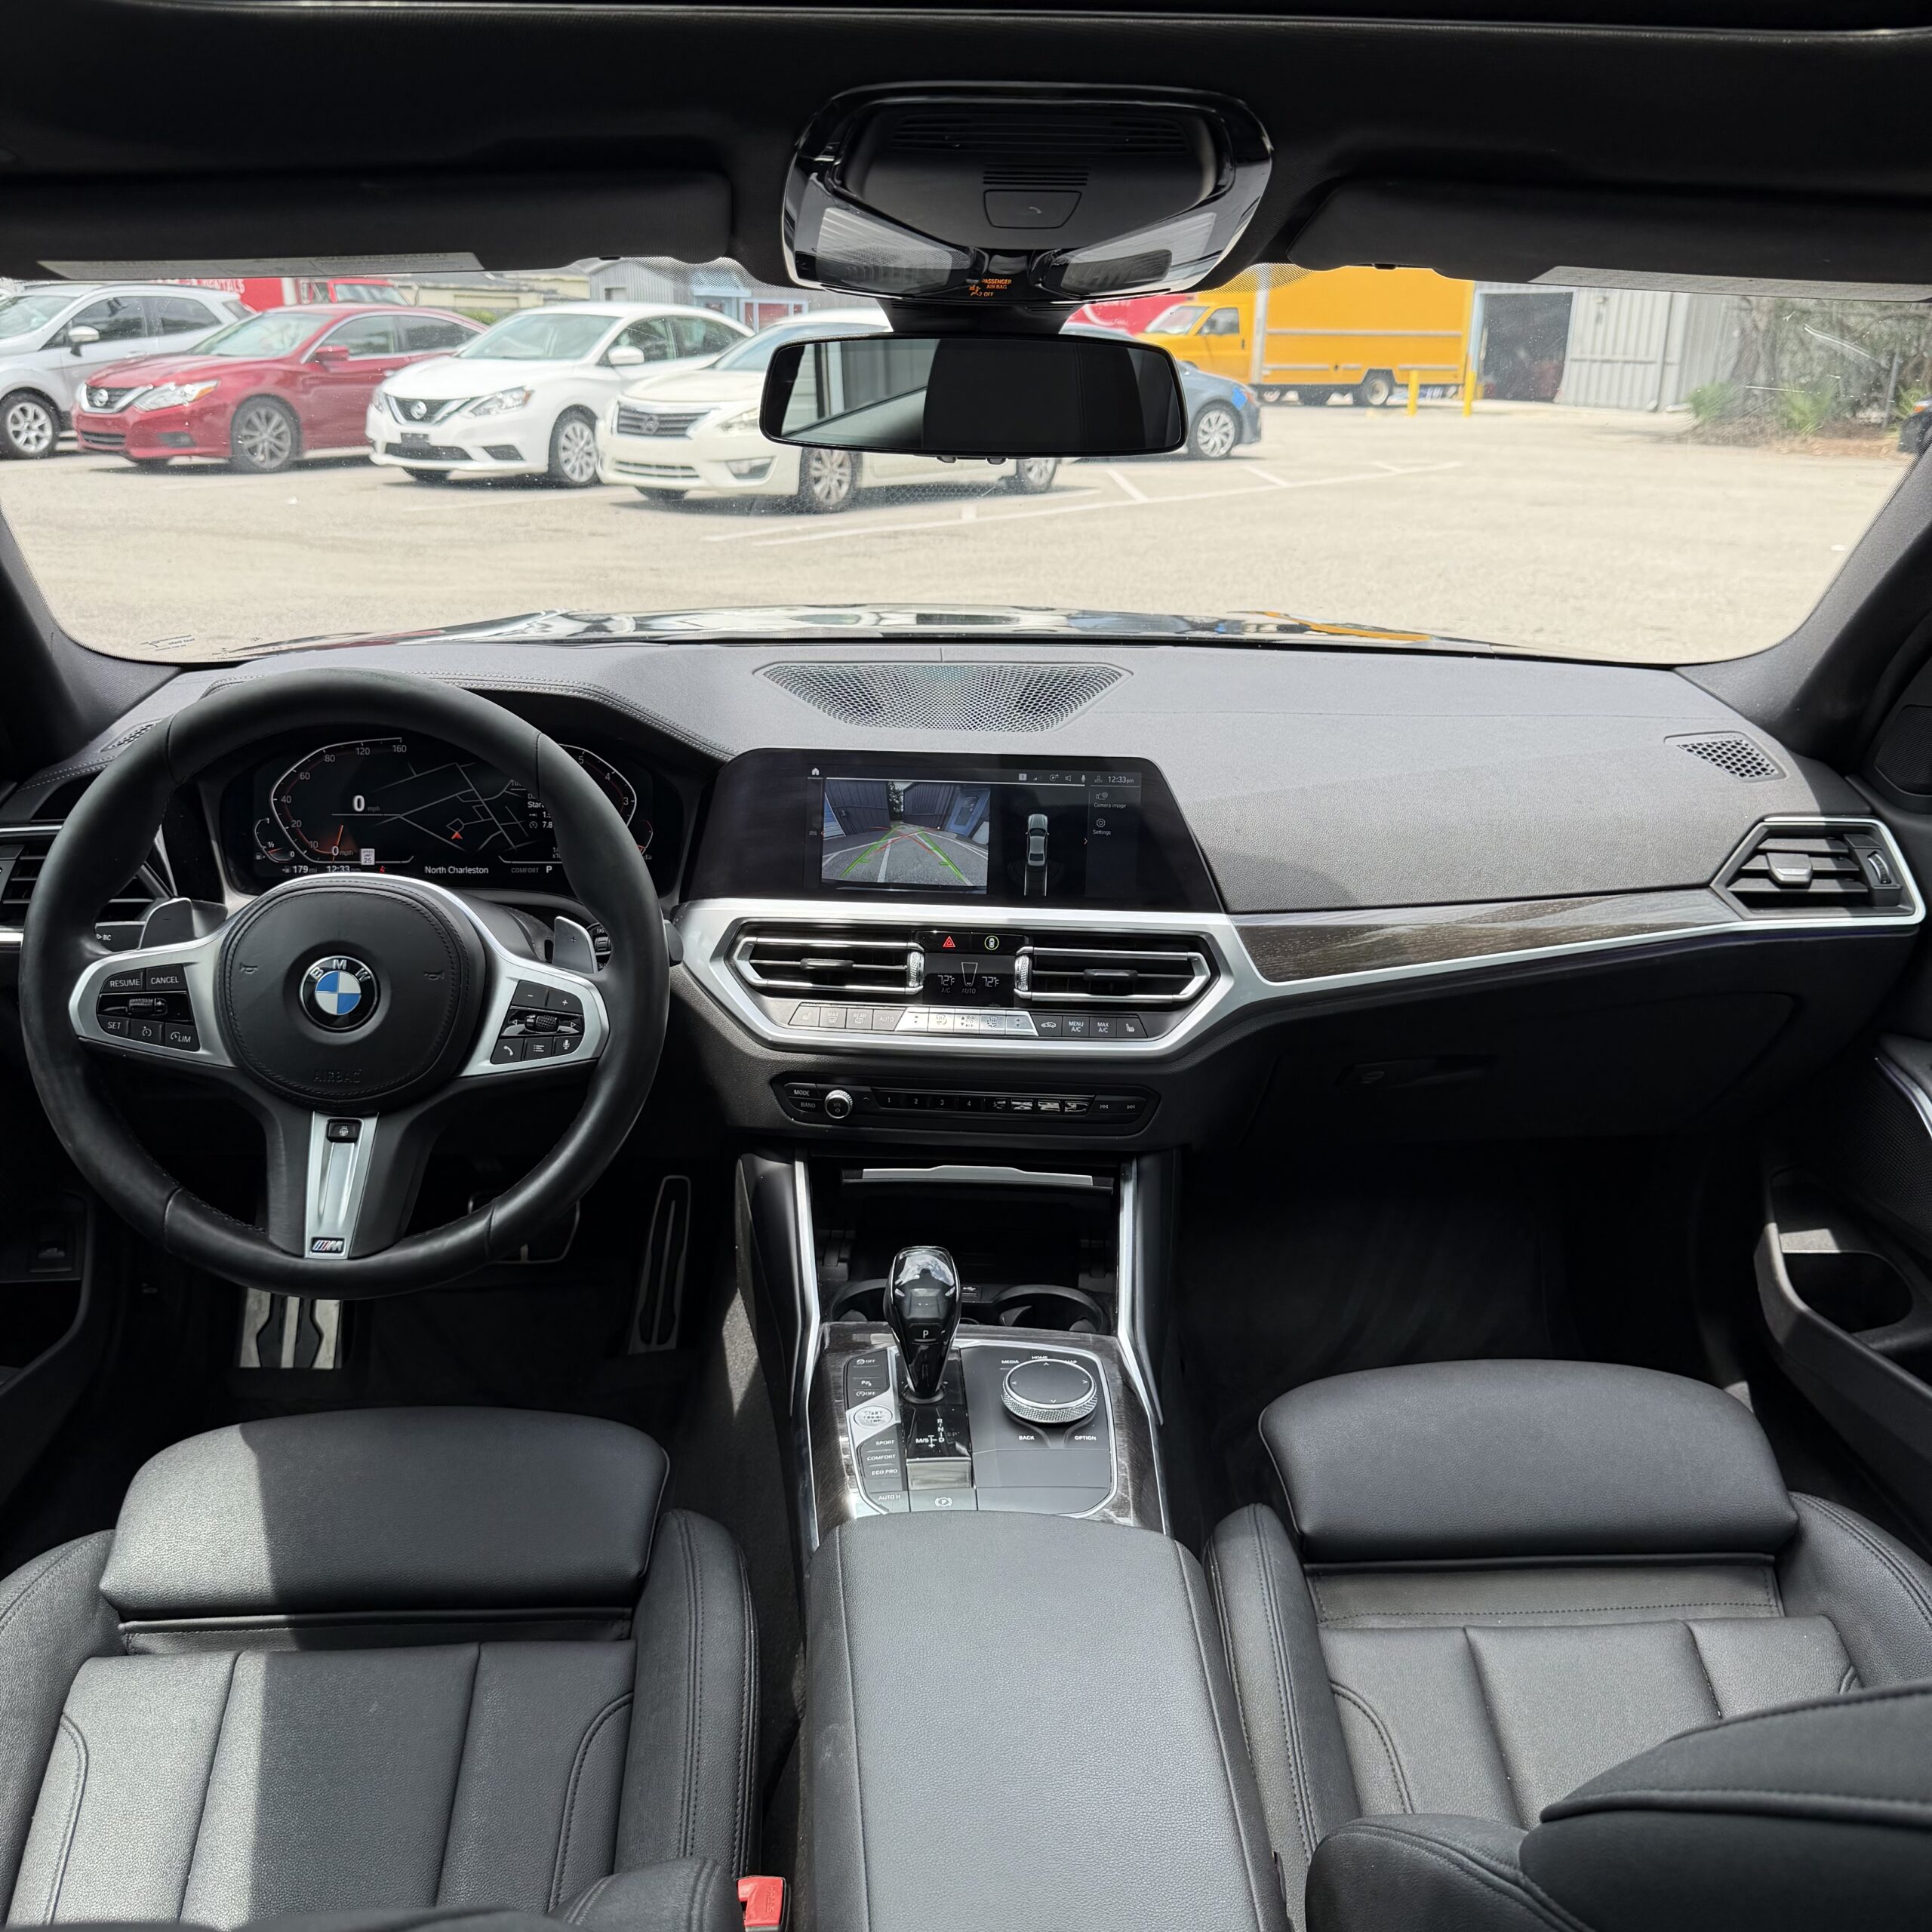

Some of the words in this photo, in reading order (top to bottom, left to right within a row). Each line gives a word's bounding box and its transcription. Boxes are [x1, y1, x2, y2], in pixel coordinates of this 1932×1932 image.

[578, 756, 583, 764] 5
[605, 773, 611, 781] 4
[281, 795, 292, 804] 40
[353, 795, 365, 811] 0
[623, 797, 629, 805] 3
[291, 820, 302, 828] 20
[332, 845, 339, 856] 0
[448, 866, 489, 874] Charleston
[309, 958, 371, 983] BMW
[110, 979, 140, 987] RESUME
[151, 976, 179, 984] CANCEL
[178, 1035, 191, 1043] LIM
[923, 1330, 929, 1339] P
